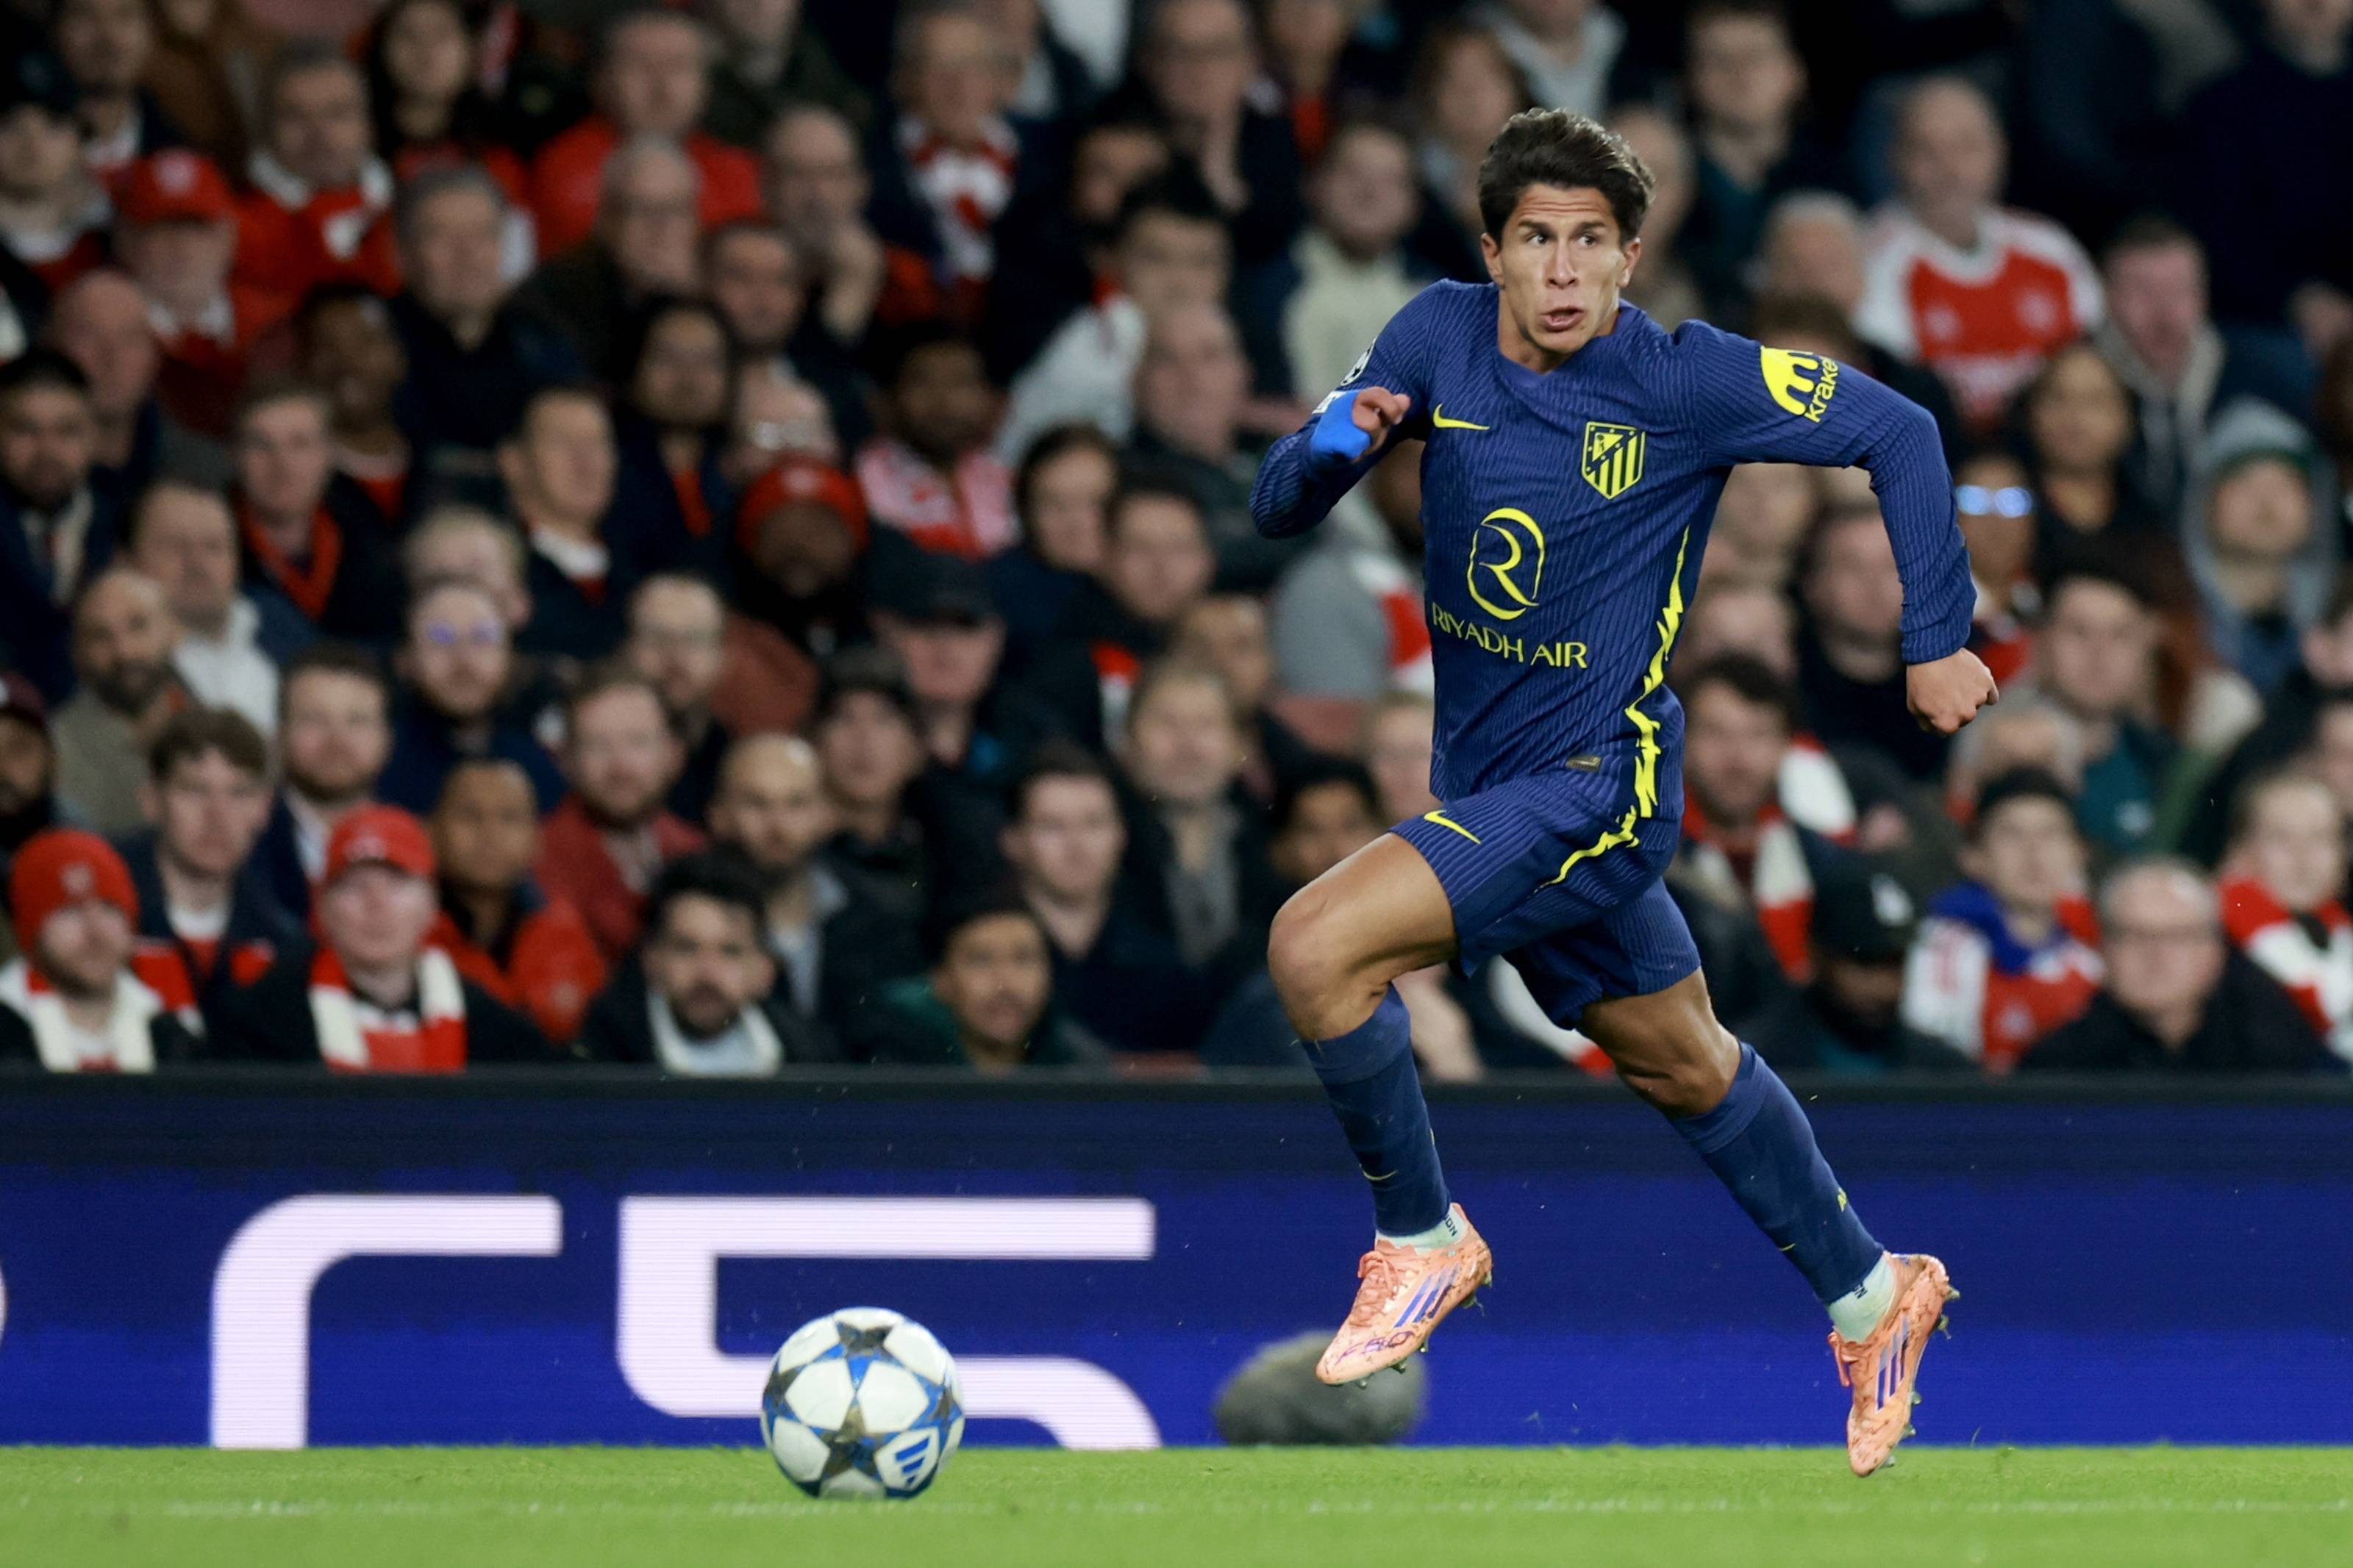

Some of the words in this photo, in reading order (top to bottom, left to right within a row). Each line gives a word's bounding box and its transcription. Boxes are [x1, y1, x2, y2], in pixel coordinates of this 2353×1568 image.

[1804, 356, 1838, 423] krake
[1432, 602, 1524, 662] RIYADH
[1530, 642, 1588, 668] AIR
[1445, 1214, 1459, 1236] ON
